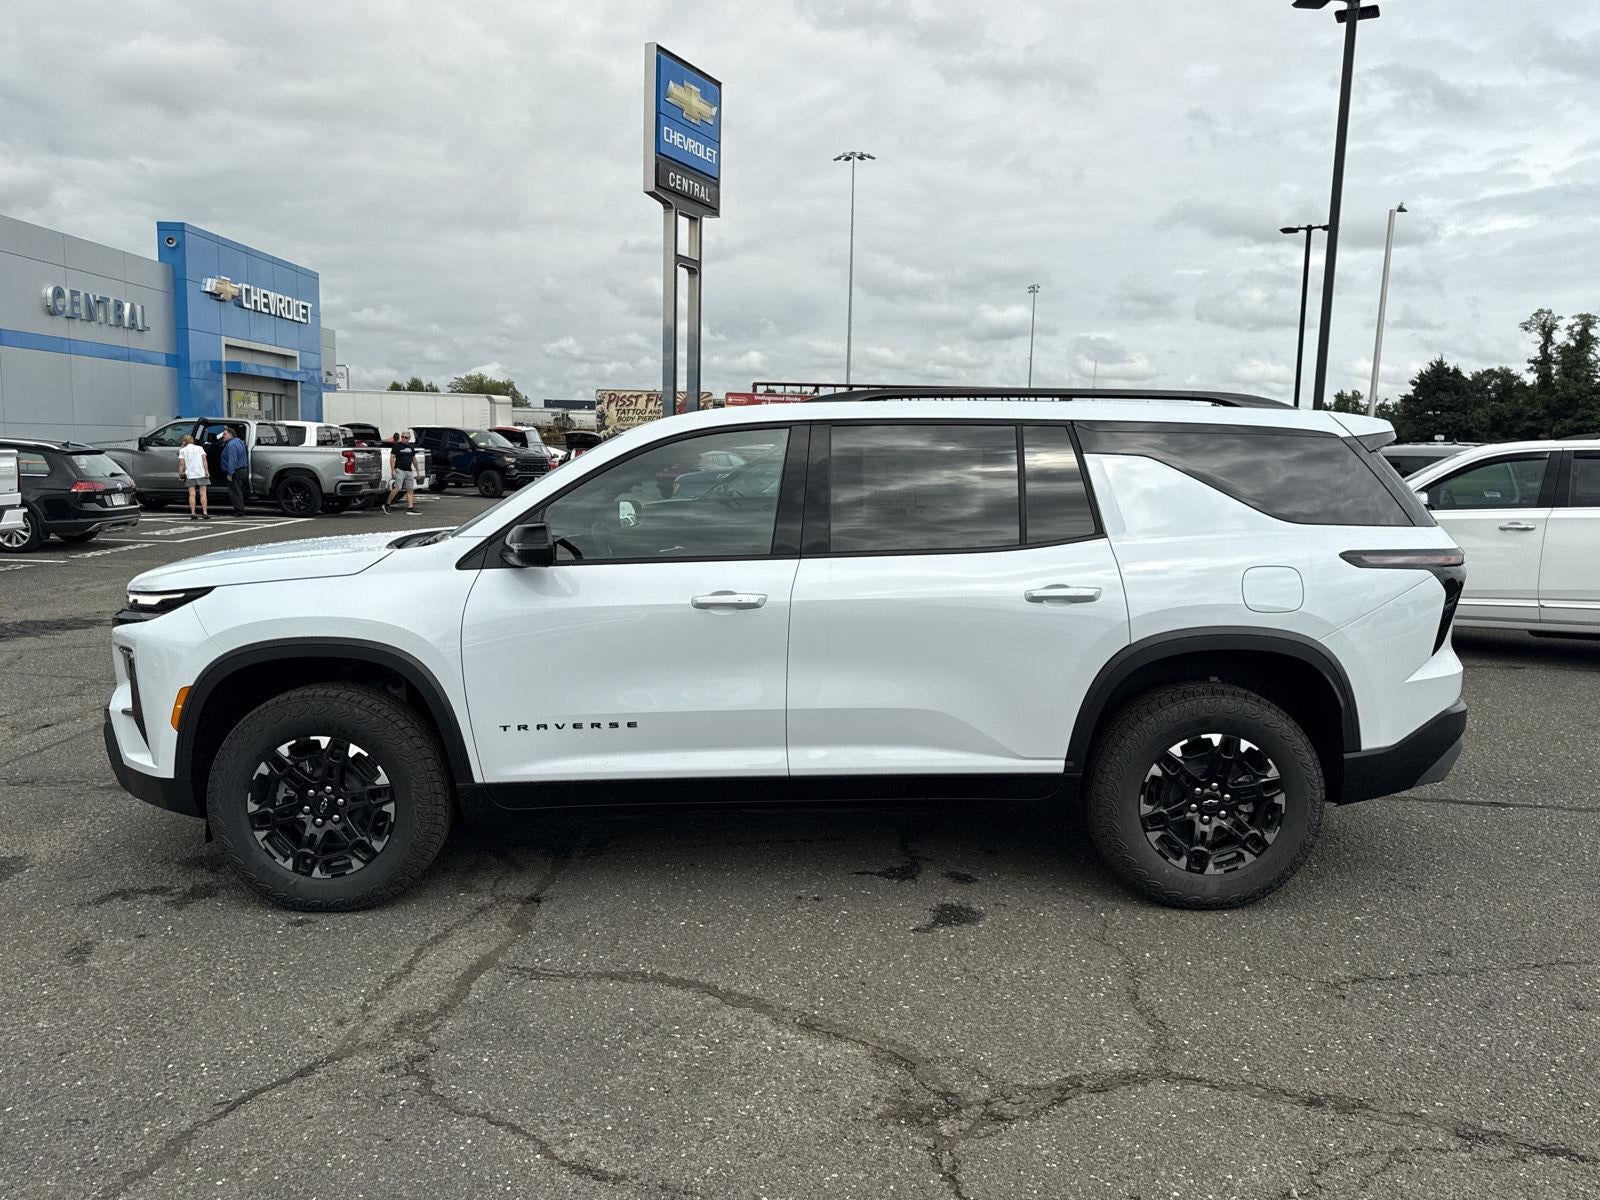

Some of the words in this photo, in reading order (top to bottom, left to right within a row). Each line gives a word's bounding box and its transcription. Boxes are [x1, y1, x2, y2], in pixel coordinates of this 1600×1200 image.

[663, 126, 717, 164] CHEVROLET
[668, 171, 711, 202] CENTRAL
[45, 285, 151, 332] CENTRAL
[241, 283, 313, 324] CHEVROLET
[606, 392, 642, 409] PISST
[615, 408, 646, 417] TATTOO
[499, 721, 638, 732] TRAVERSE
